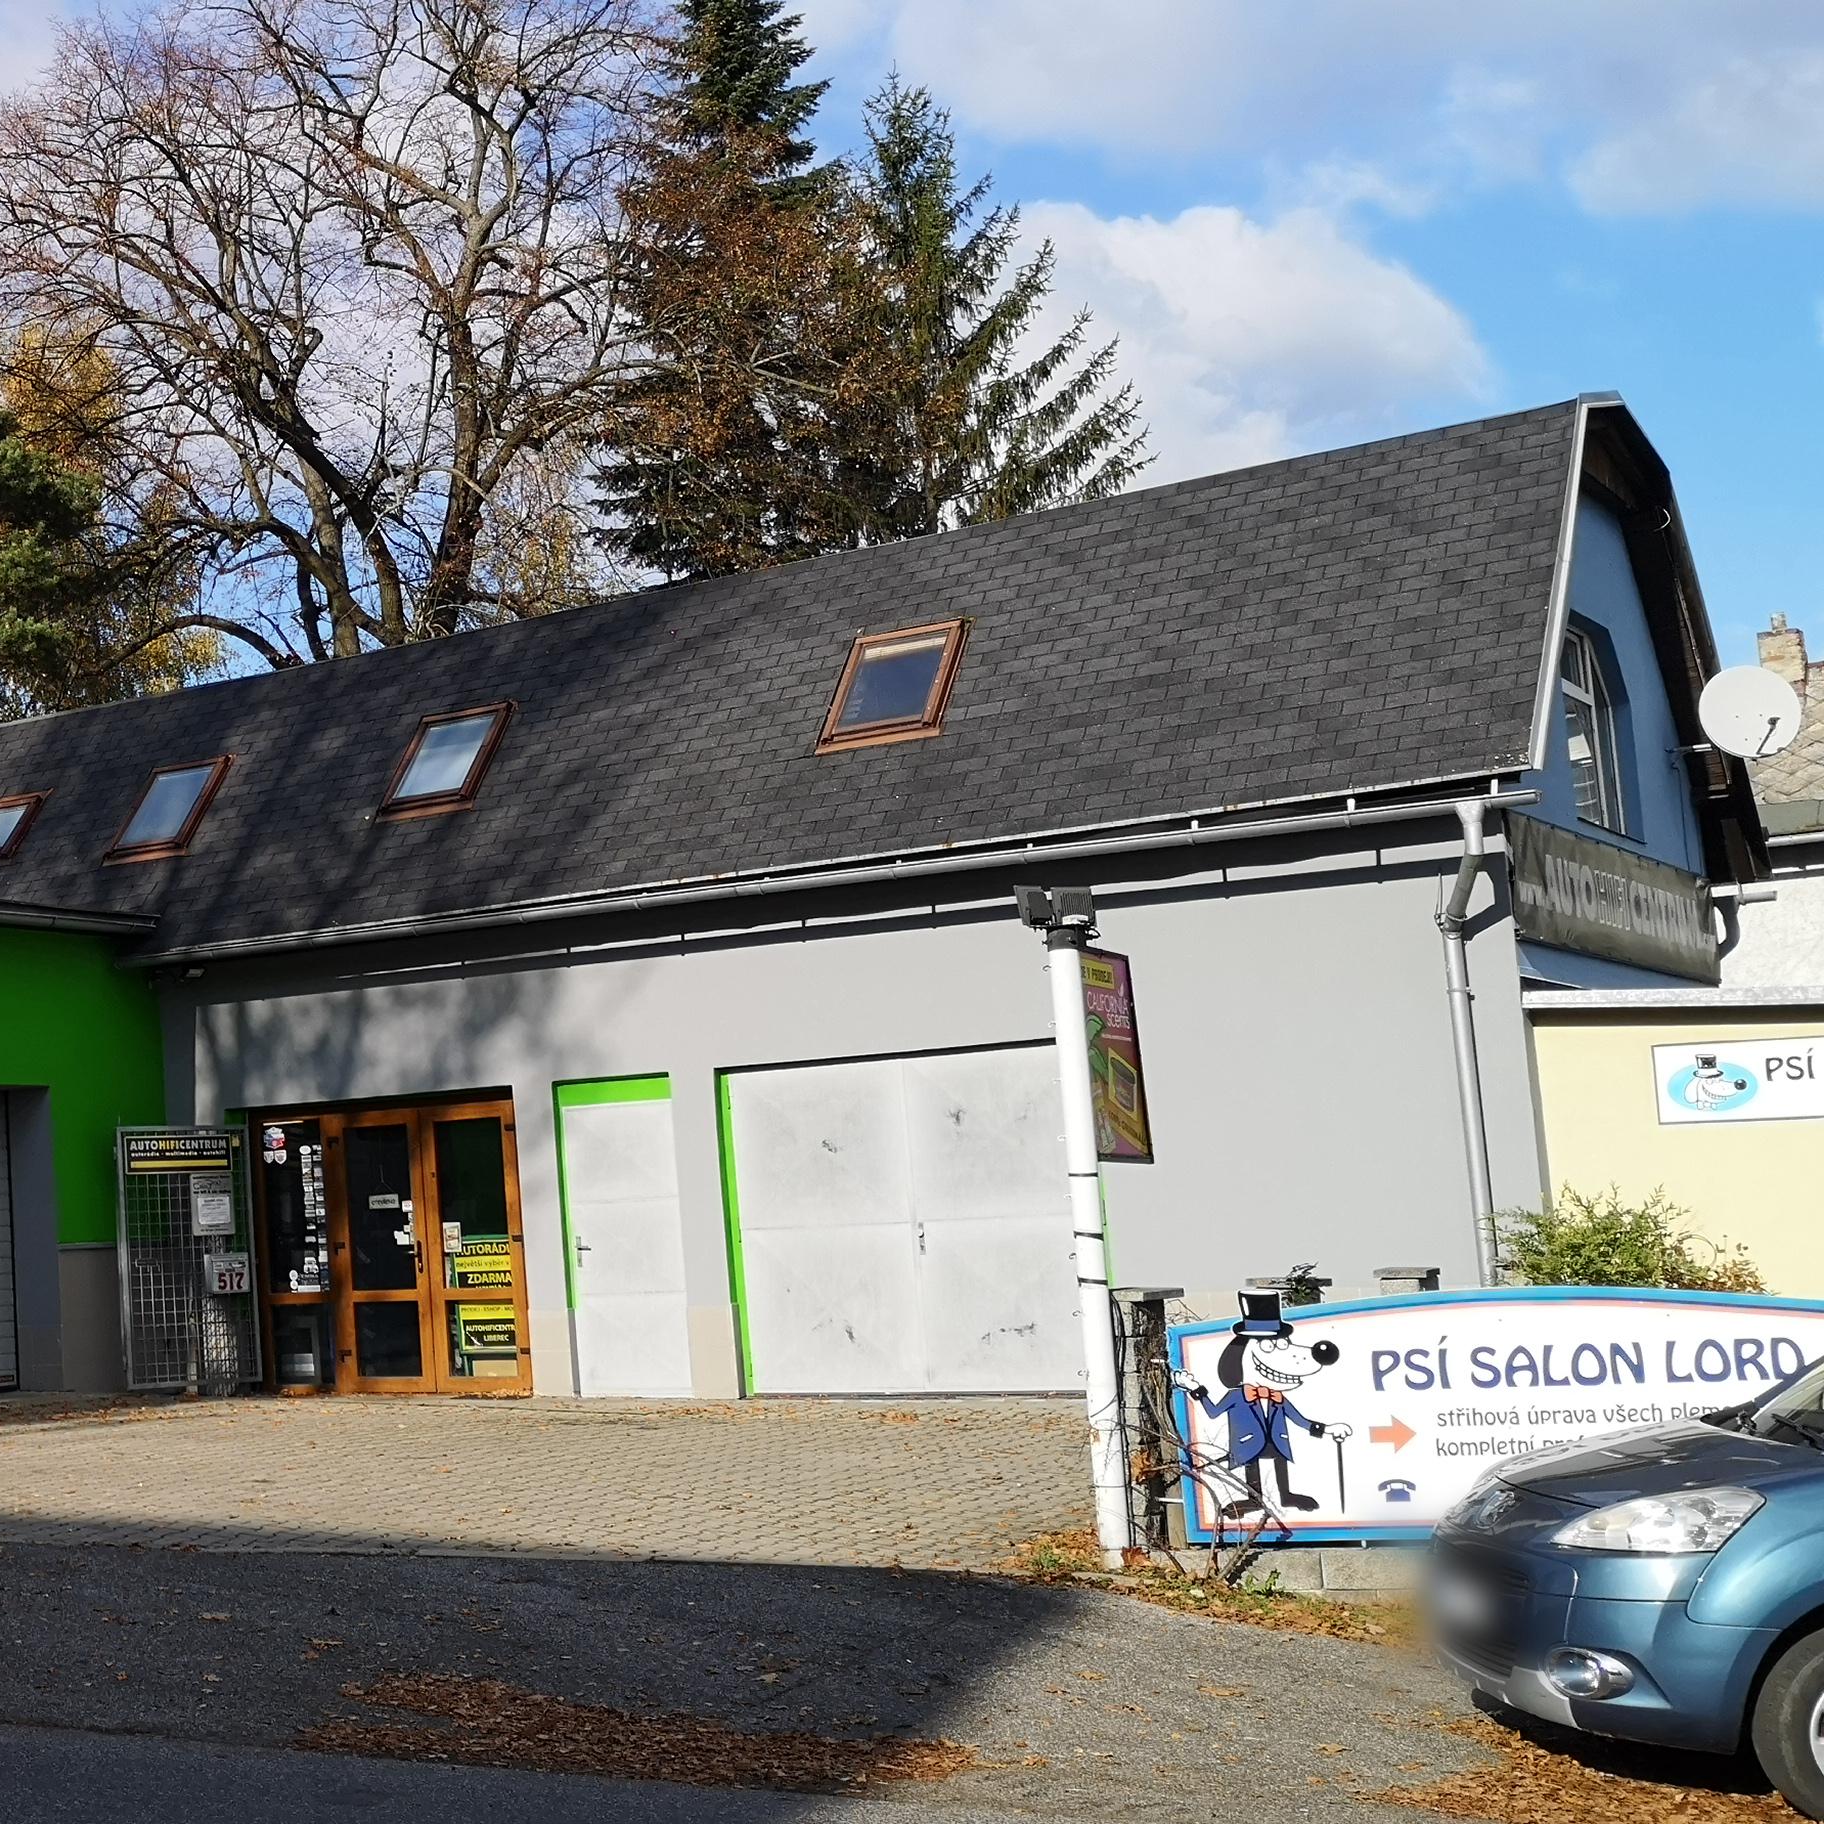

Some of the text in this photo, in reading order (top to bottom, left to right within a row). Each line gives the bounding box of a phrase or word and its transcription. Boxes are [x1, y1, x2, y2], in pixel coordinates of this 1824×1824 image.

[1087, 991, 1129, 1015] CALIFORNIA
[1106, 1013, 1130, 1029] scents
[1765, 1047, 1815, 1081] PSÍ
[129, 1139, 227, 1151] AUTOHIFICENTRUM
[218, 1272, 245, 1290] 517
[466, 1272, 512, 1285] ZDARMA
[1371, 1335, 1806, 1391] PSÍ SALON LORD
[1437, 1406, 1520, 1427] střihová
[1528, 1405, 1598, 1425] úprava
[1603, 1403, 1663, 1423] všech
[1436, 1434, 1535, 1456] kompletní
